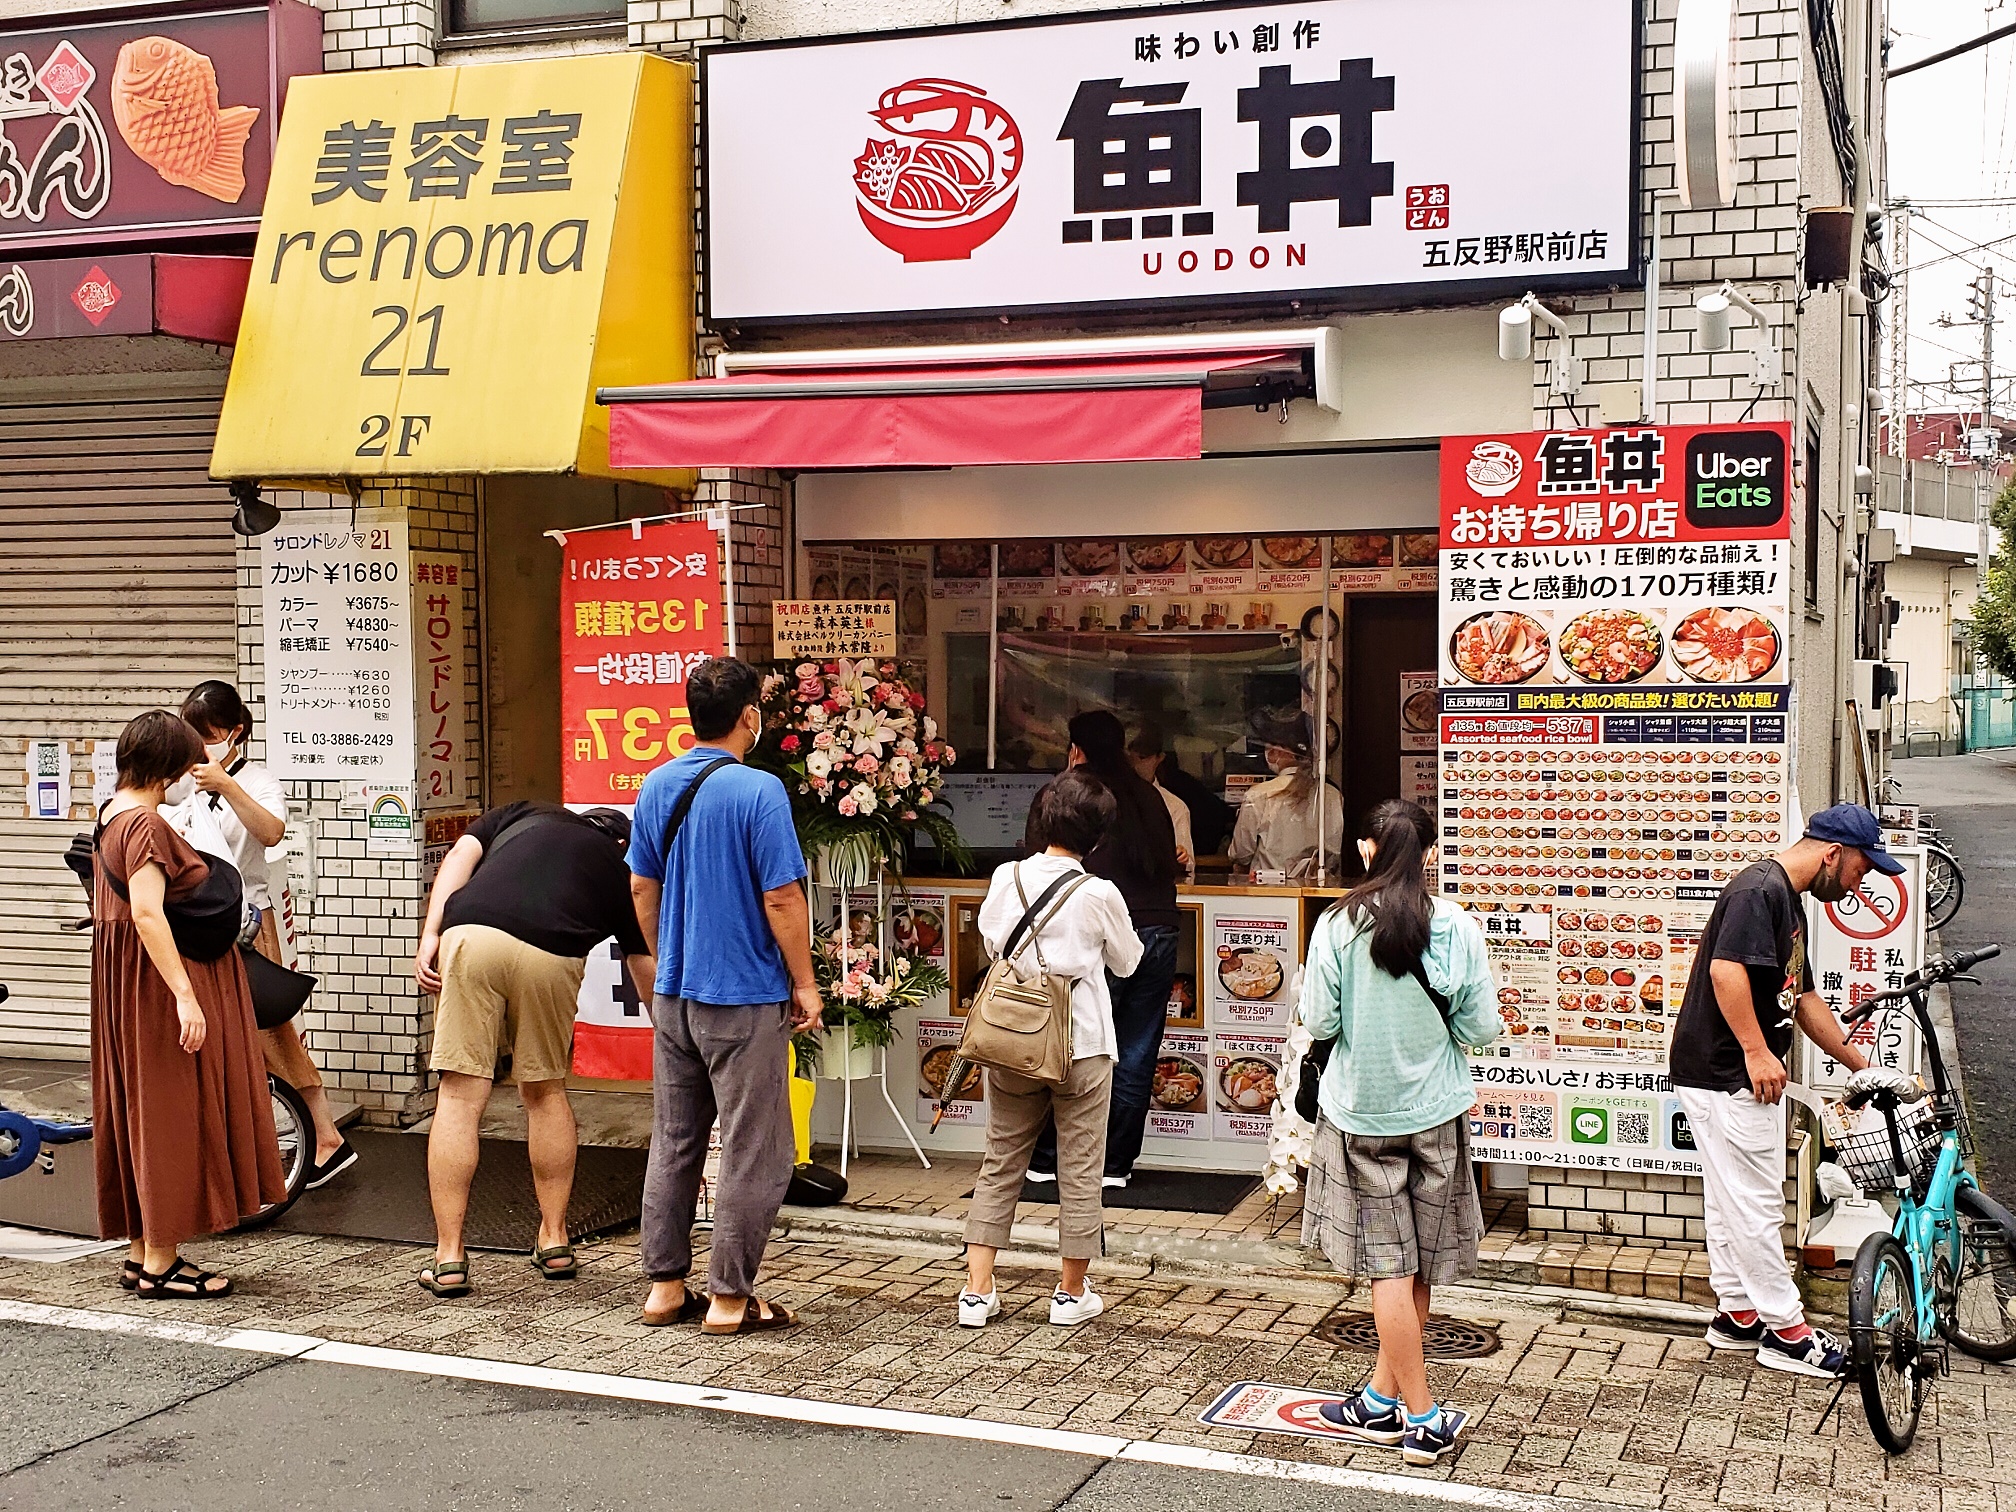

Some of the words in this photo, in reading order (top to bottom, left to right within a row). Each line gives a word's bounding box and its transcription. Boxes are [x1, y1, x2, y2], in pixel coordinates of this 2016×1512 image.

[1134, 20, 1321, 63] 味わい創作
[312, 109, 583, 205] 美容室
[1056, 57, 1395, 244] 魚丼
[1408, 186, 1447, 206] うお
[1408, 208, 1447, 229] どん
[270, 218, 589, 284] renoma
[1143, 243, 1306, 276] UODON
[1422, 229, 1609, 269] 五反野駅前店
[360, 304, 450, 377] 21
[355, 415, 431, 457] 2F
[1533, 430, 1665, 497] 魚丼
[1696, 451, 1773, 480] Uber
[1696, 483, 1772, 509] Eats
[1450, 499, 1679, 544] お持ち帰り店
[273, 531, 367, 551] サロンドレノマ
[370, 529, 392, 550] 21
[271, 560, 318, 585] カット
[323, 561, 398, 585] ¥1680
[417, 562, 458, 586] 美容室
[1450, 569, 1777, 602] 驚きと感動の170万種類!
[279, 597, 318, 612] カラー
[279, 617, 319, 632] パーマ
[784, 619, 811, 627] オーナー
[279, 637, 331, 652] 縮毛矯正
[280, 668, 328, 679] シャンプー
[353, 669, 390, 680] ¥630
[426, 594, 453, 762] サロンドレノマ
[281, 683, 310, 694] ブロー
[348, 684, 390, 696] ¥1260
[281, 698, 337, 709] トリートメント
[348, 698, 391, 709] ¥1050
[282, 732, 307, 744] TEL
[312, 733, 394, 746] 03-3886-2429
[1450, 734, 1498, 743] Assorted
[1500, 734, 1543, 743] seafood
[1545, 734, 1565, 743] rice
[1567, 734, 1593, 743] bowl
[429, 769, 453, 796] 21
[1486, 917, 1521, 934] 魚丼
[1229, 1005, 1274, 1015] 税別750円
[1483, 1104, 1512, 1119] 魚丼
[1573, 1096, 1648, 1107] クーポンをGETする
[1151, 1118, 1194, 1128] 税別537円
[1580, 1120, 1599, 1129] LINE
